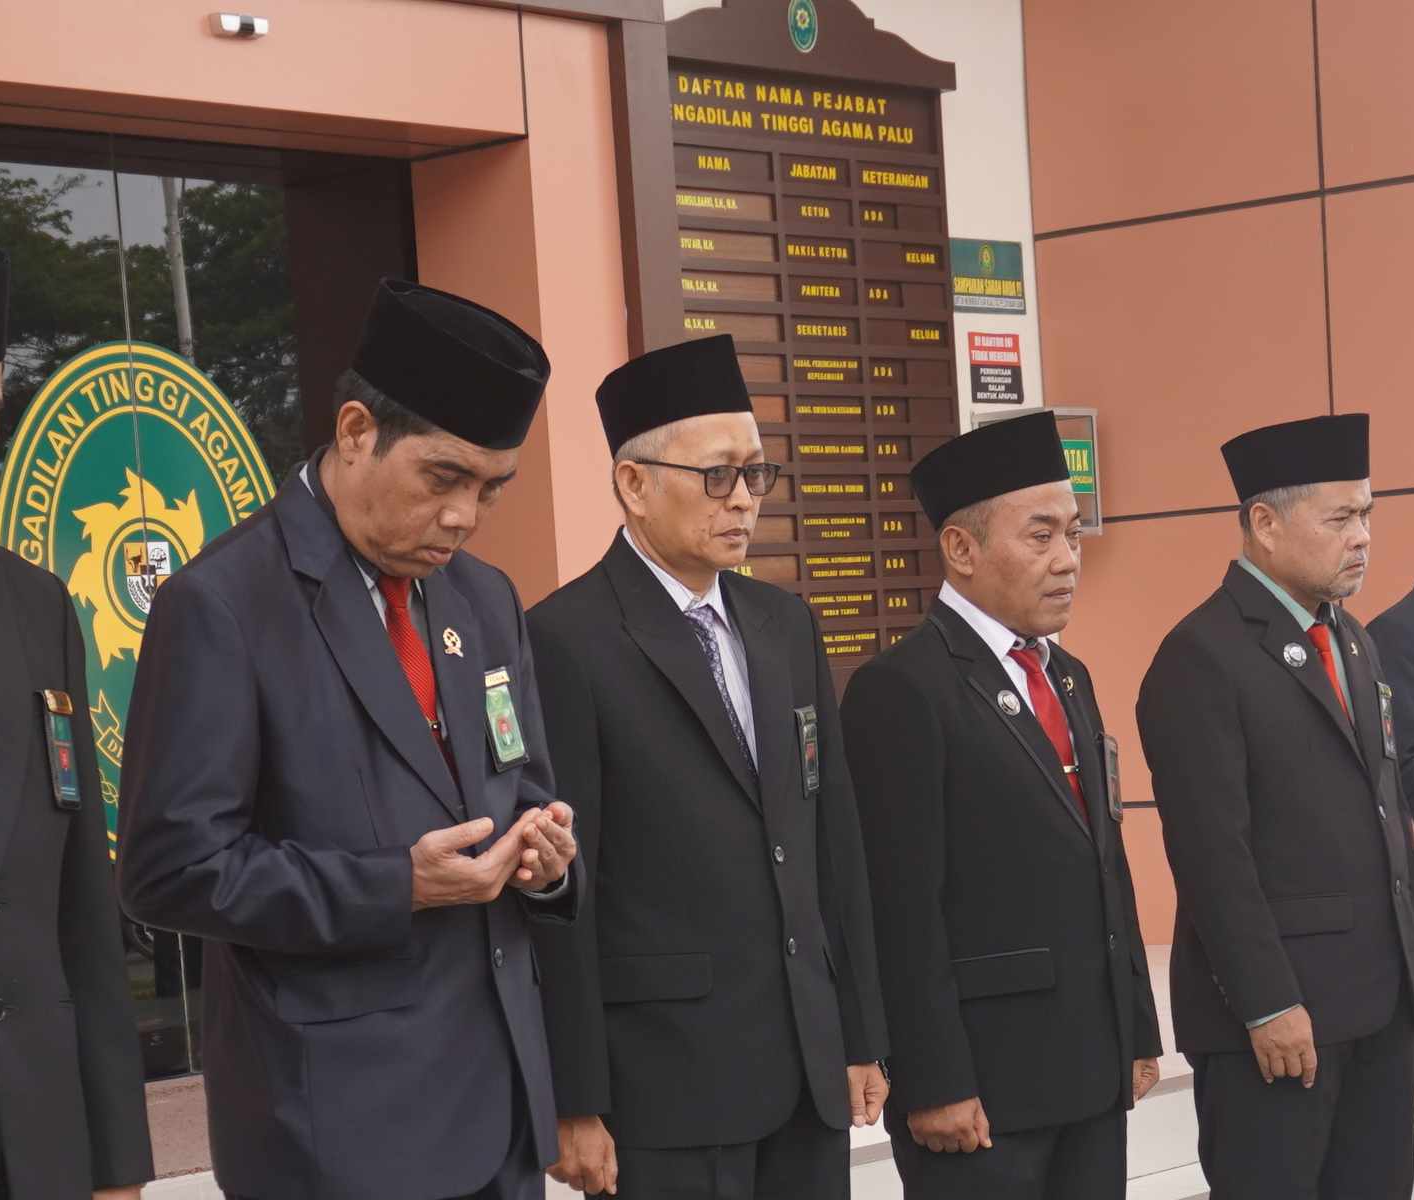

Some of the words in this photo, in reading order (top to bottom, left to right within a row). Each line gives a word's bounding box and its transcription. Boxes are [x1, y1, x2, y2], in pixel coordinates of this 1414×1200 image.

[678, 76, 746, 99] DAFTAR
[756, 85, 804, 106] NAMA
[813, 91, 886, 115] PEJABAT
[671, 103, 752, 129] NGADILAN
[761, 113, 814, 134] TINGGI
[822, 119, 873, 140] AGAMA
[878, 125, 913, 144] PALU
[698, 155, 731, 171] NAMA
[790, 163, 836, 180] JABATAN
[862, 170, 929, 189] KETERANGAN
[801, 206, 830, 218] KETUA
[863, 210, 883, 222] ADA
[787, 244, 816, 257] WAKIL
[819, 247, 848, 259] KETUA
[906, 252, 935, 264] KELUAR
[801, 285, 840, 297] PANITERA
[869, 288, 888, 300] ADA
[796, 325, 848, 337] SEKRETARIS
[910, 328, 940, 340] KELUAR
[874, 366, 893, 377] ADA
[876, 405, 895, 416] ADA
[878, 444, 898, 455] ADA
[1064, 449, 1089, 471] OTAK
[19, 403, 84, 563] GADILAN
[80, 370, 190, 418] TINGGI
[190, 412, 254, 518] AGAM
[884, 521, 902, 531] ADA
[886, 558, 905, 569] ADA
[888, 597, 908, 608] ADA
